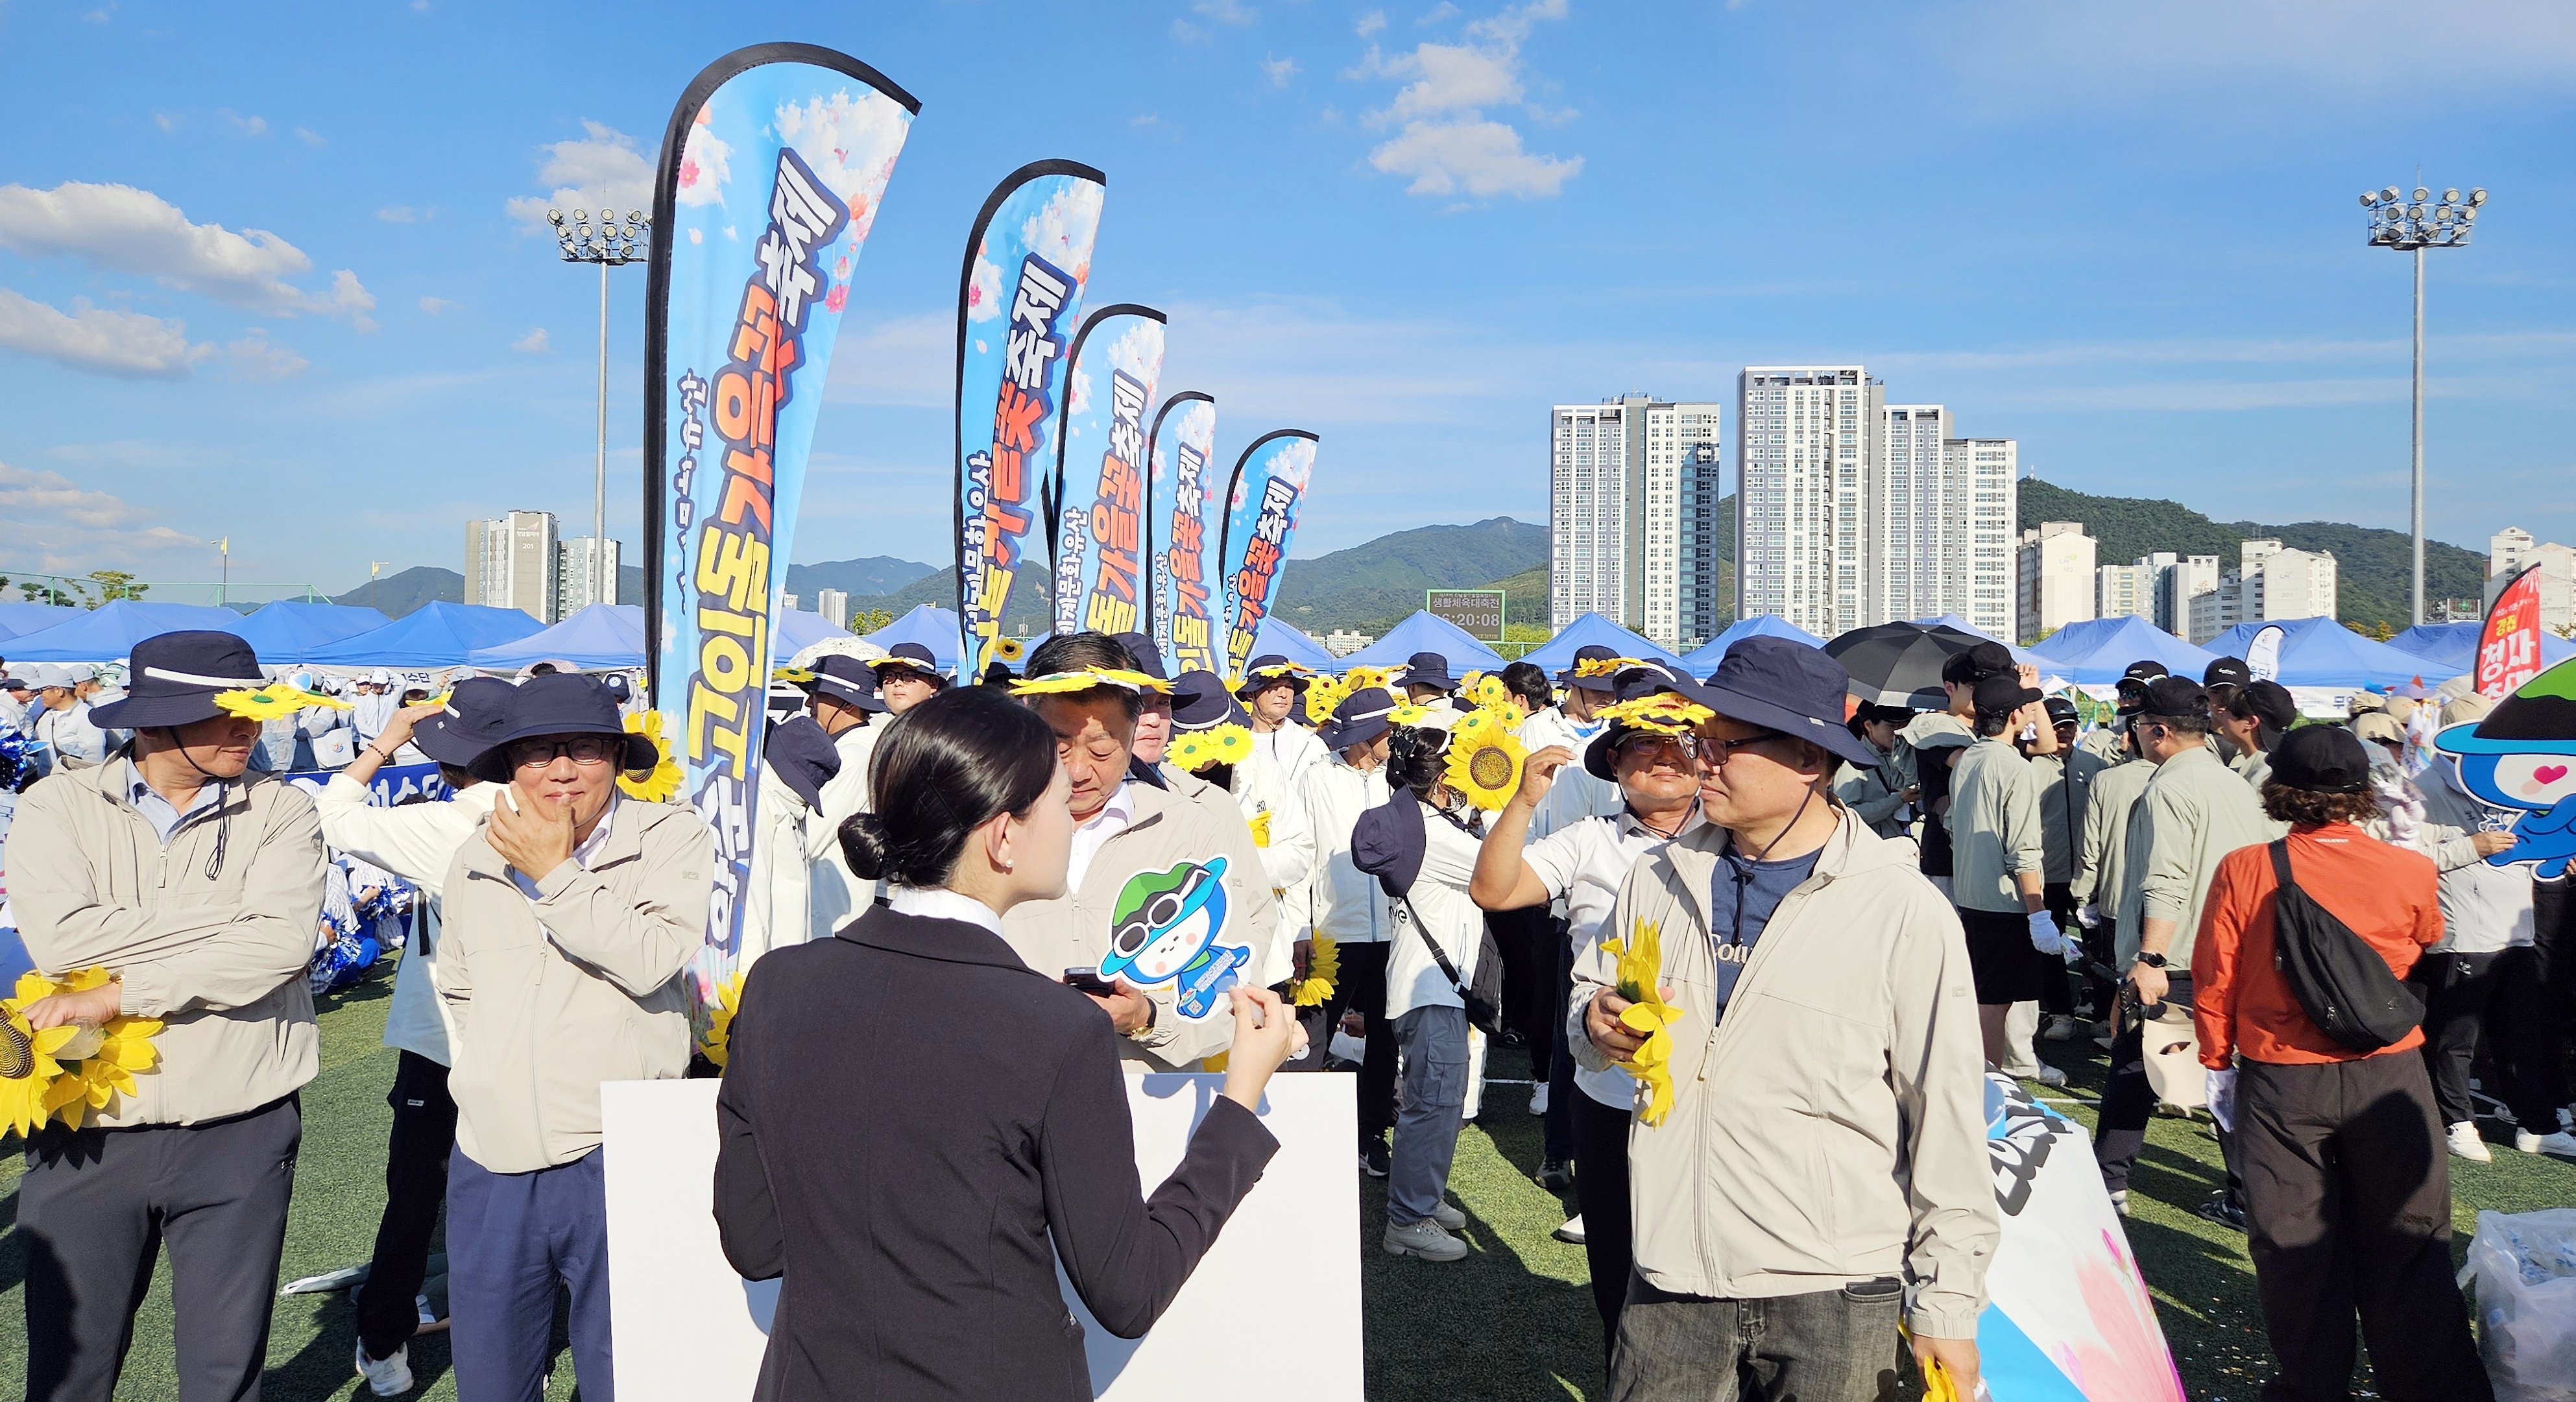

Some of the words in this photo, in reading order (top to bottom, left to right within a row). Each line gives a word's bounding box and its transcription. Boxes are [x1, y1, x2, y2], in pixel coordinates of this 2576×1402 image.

[1004, 260, 1066, 389] 축제
[1109, 374, 1145, 467] 축제
[688, 526, 769, 780] 고인돌
[760, 154, 836, 326] 축제
[1177, 448, 1202, 517] 축제
[1257, 479, 1294, 545] 축제
[1093, 455, 1141, 601] 가을꽃
[1170, 512, 1206, 618] 가을꽃
[1156, 553, 1168, 657] 세계문화유산
[1237, 535, 1279, 627] 가을꽃
[1433, 598, 1499, 609] 생활체육대축전
[1436, 613, 1500, 627] 6:20:08
[2481, 628, 2536, 682] 청자
